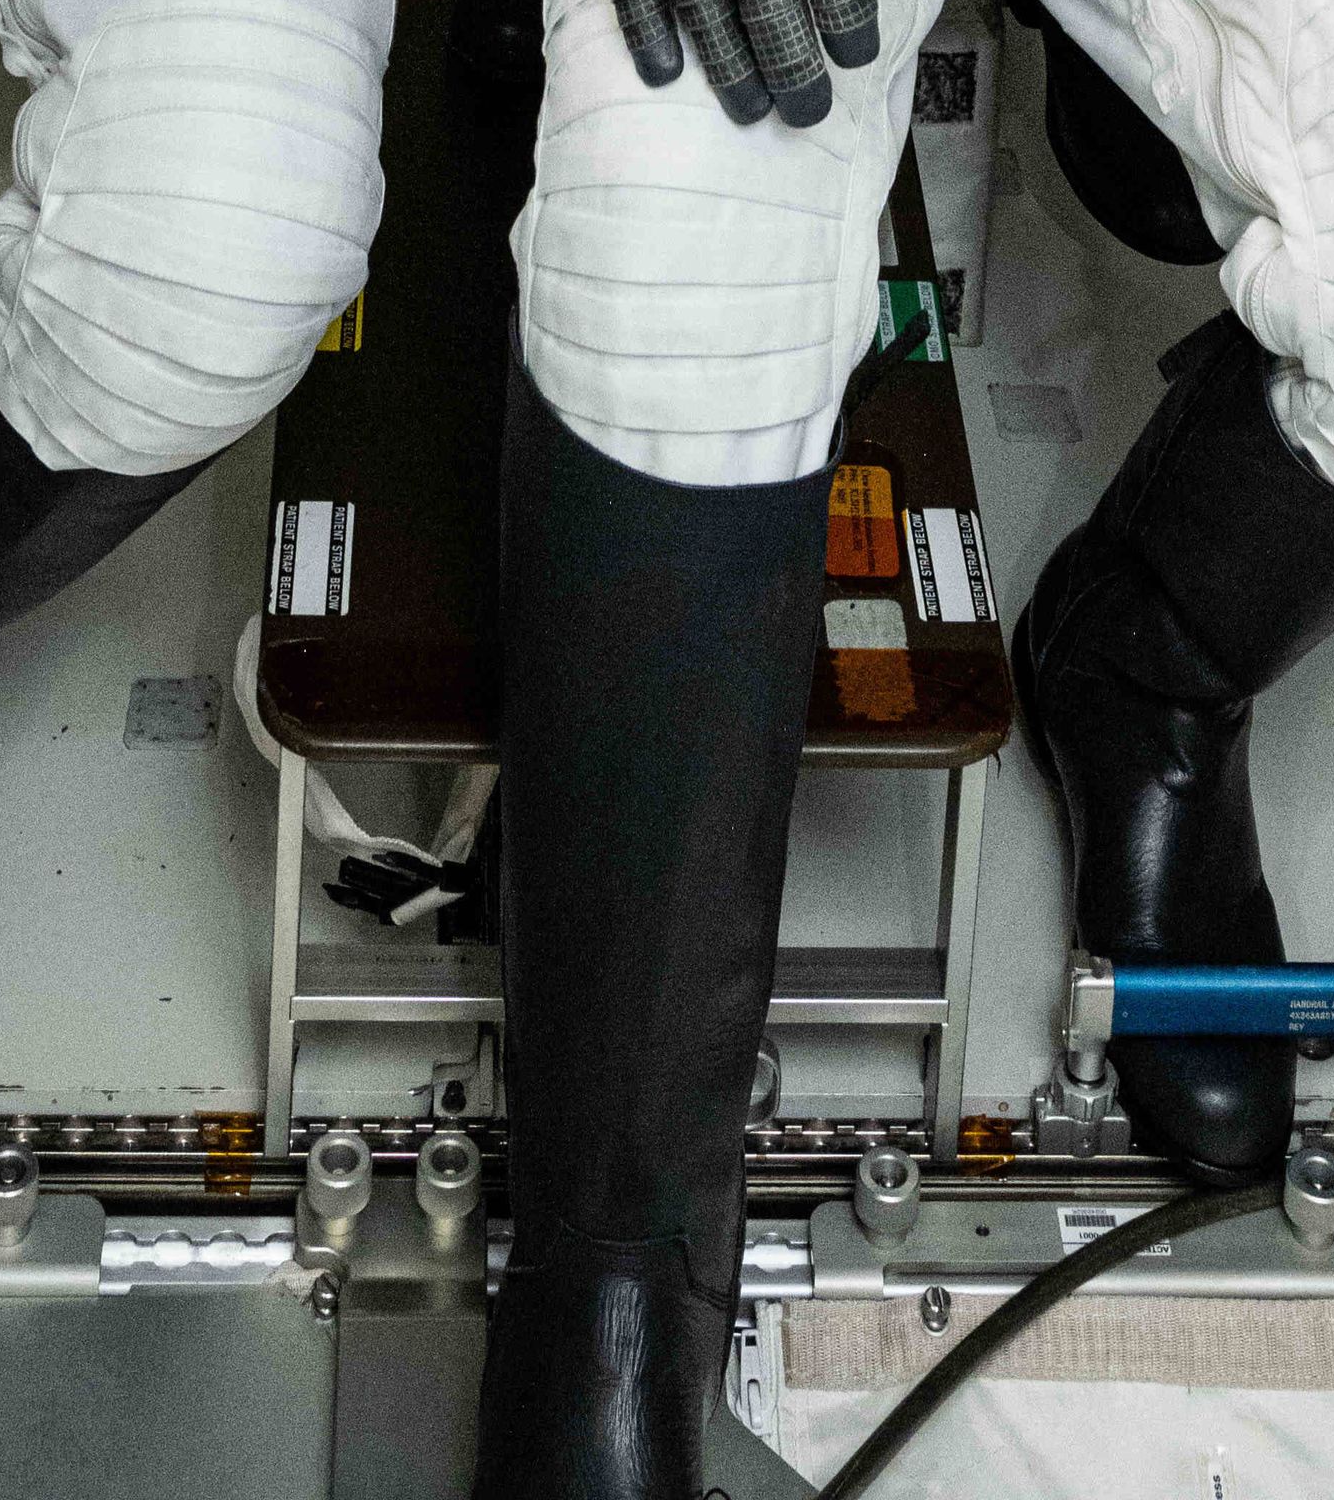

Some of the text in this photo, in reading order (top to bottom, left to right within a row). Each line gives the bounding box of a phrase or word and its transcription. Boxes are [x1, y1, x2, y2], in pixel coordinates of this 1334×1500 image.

[279, 506, 296, 607] PATIENT STRAP BELOW
[329, 507, 345, 608] PATIENT STRAP BELOW
[912, 512, 937, 617] PATIENT STRAP BELOW
[960, 512, 986, 617] PATIENT STRAP BELOW
[1289, 1000, 1327, 1009] HANDRAIL
